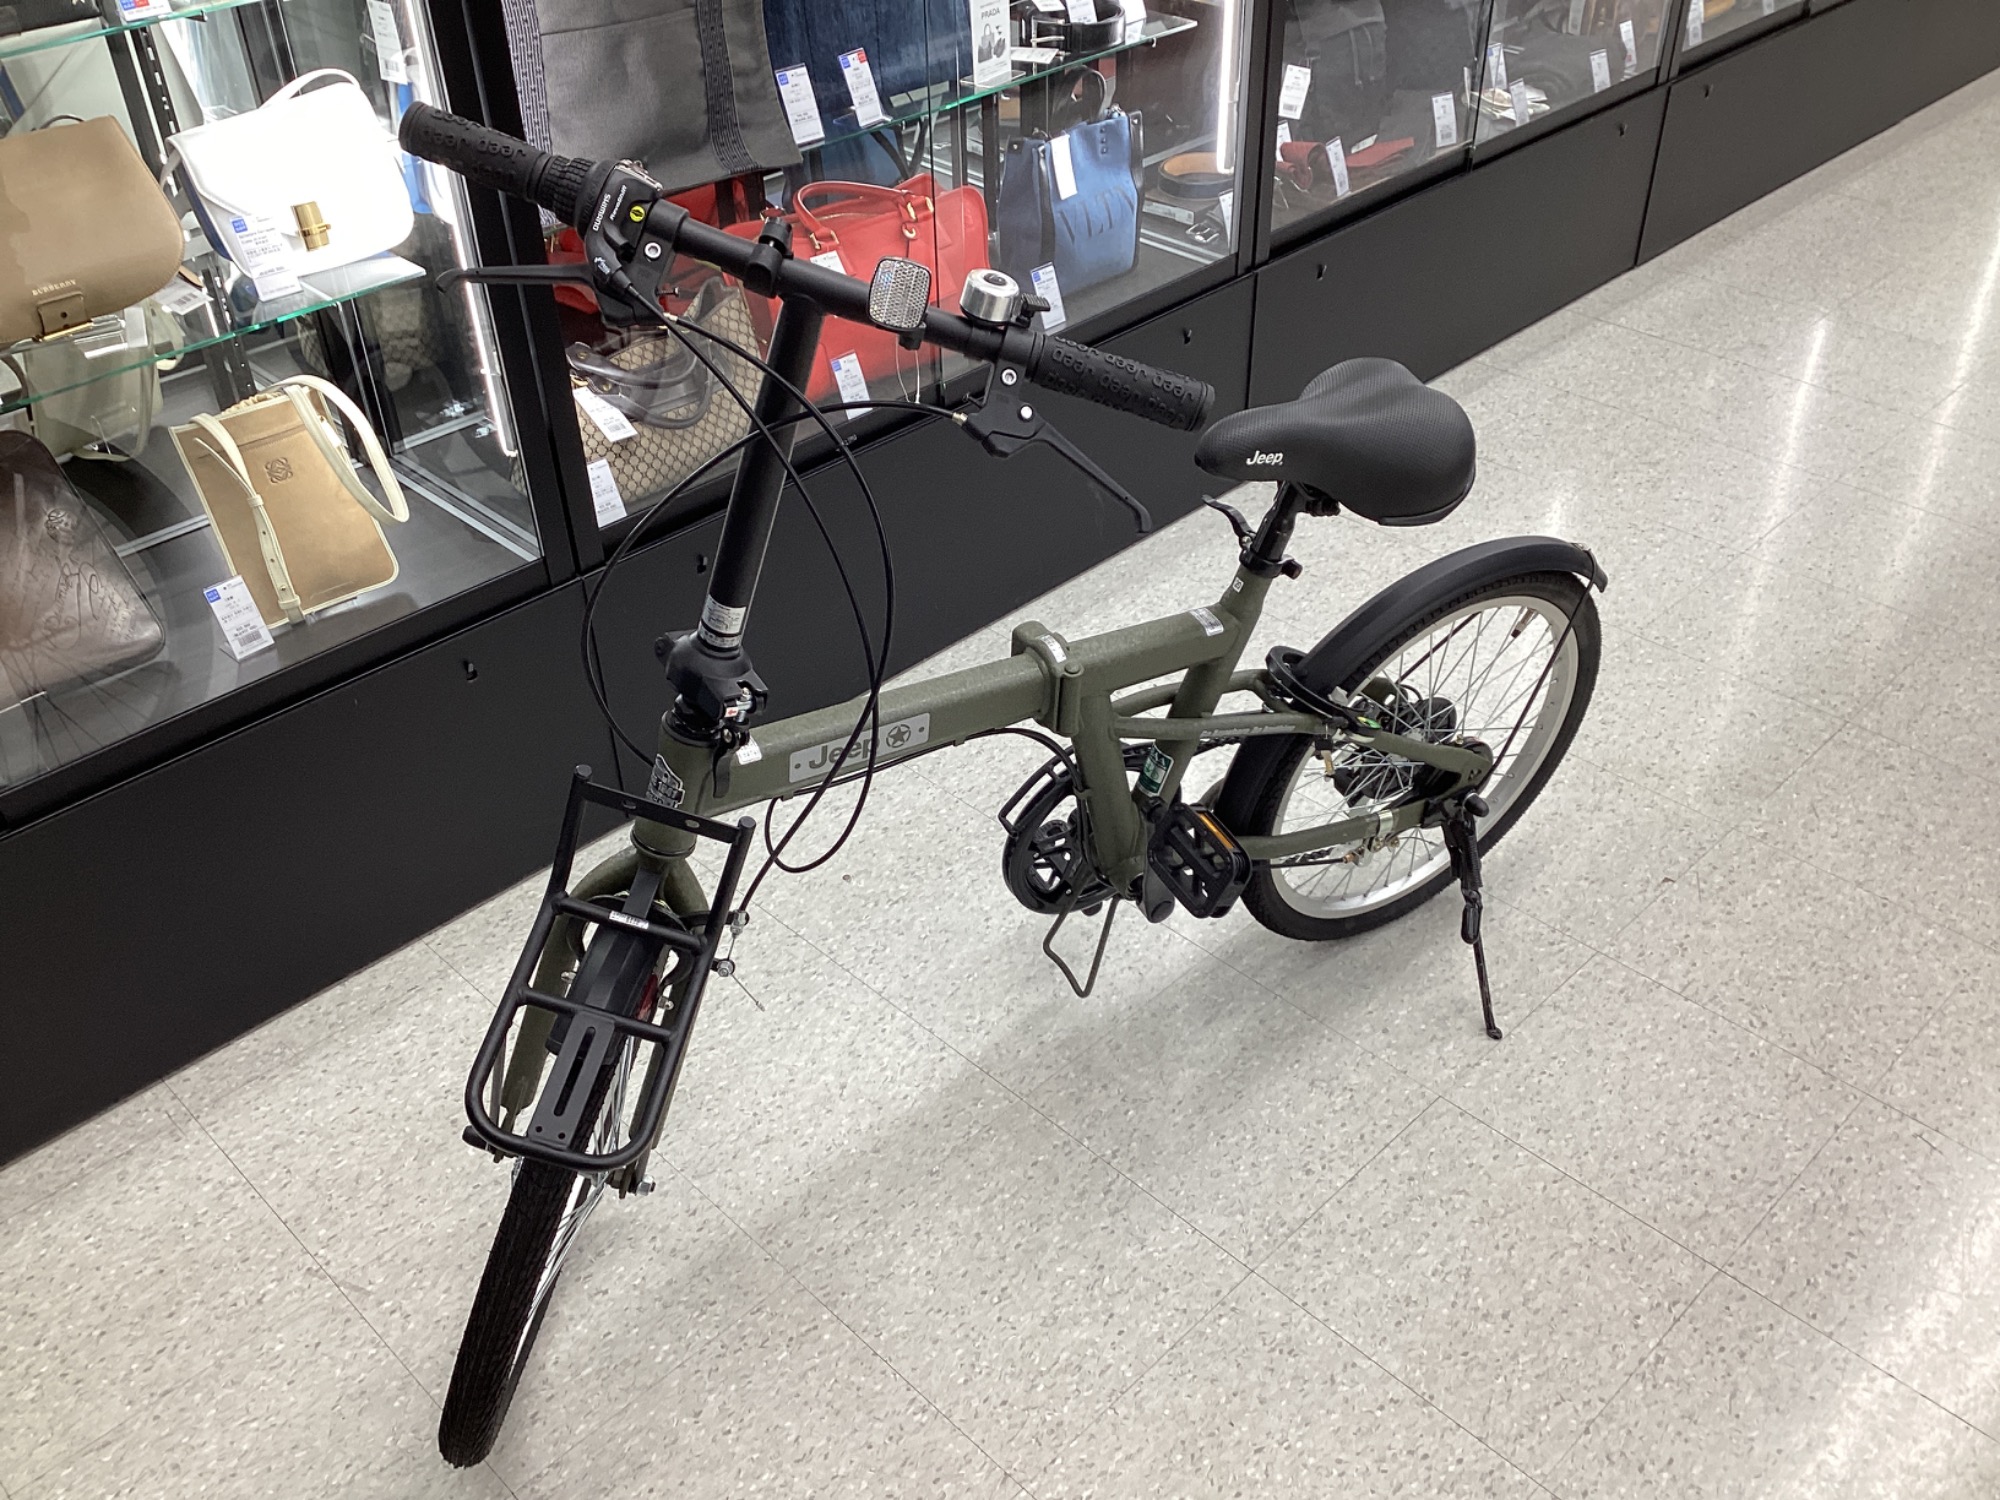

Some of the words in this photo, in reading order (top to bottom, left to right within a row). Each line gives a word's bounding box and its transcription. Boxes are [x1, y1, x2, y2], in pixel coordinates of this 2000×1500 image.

[592, 193, 611, 232] SHIMANO
[32, 279, 76, 296] BURBERRY
[1246, 450, 1283, 465] Jeep
[809, 738, 876, 769] Jeep
